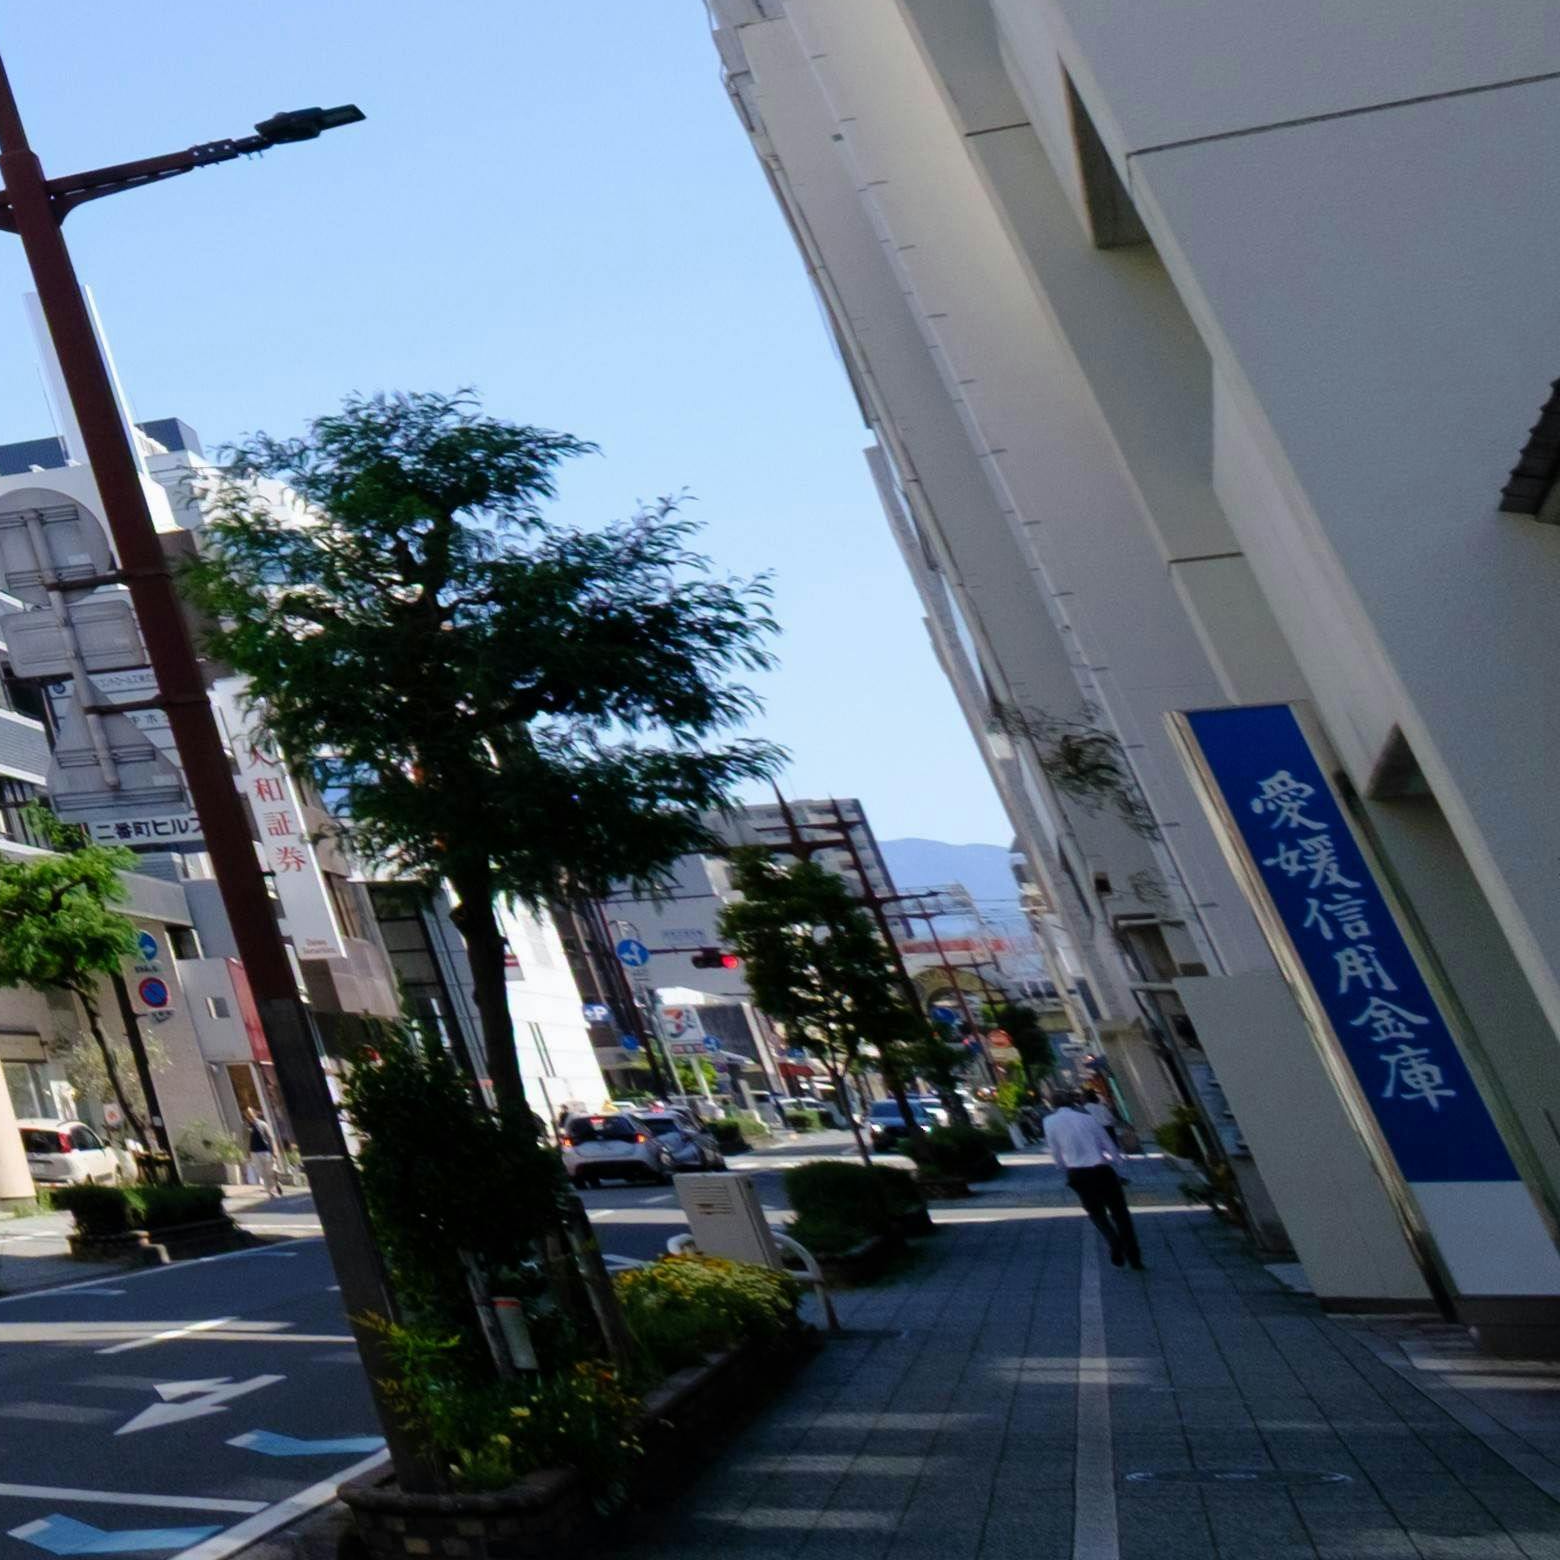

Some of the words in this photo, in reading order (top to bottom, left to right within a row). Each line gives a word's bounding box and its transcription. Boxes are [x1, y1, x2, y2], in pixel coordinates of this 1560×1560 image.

[1249, 769, 1458, 1111] 愛媛信用金庫
